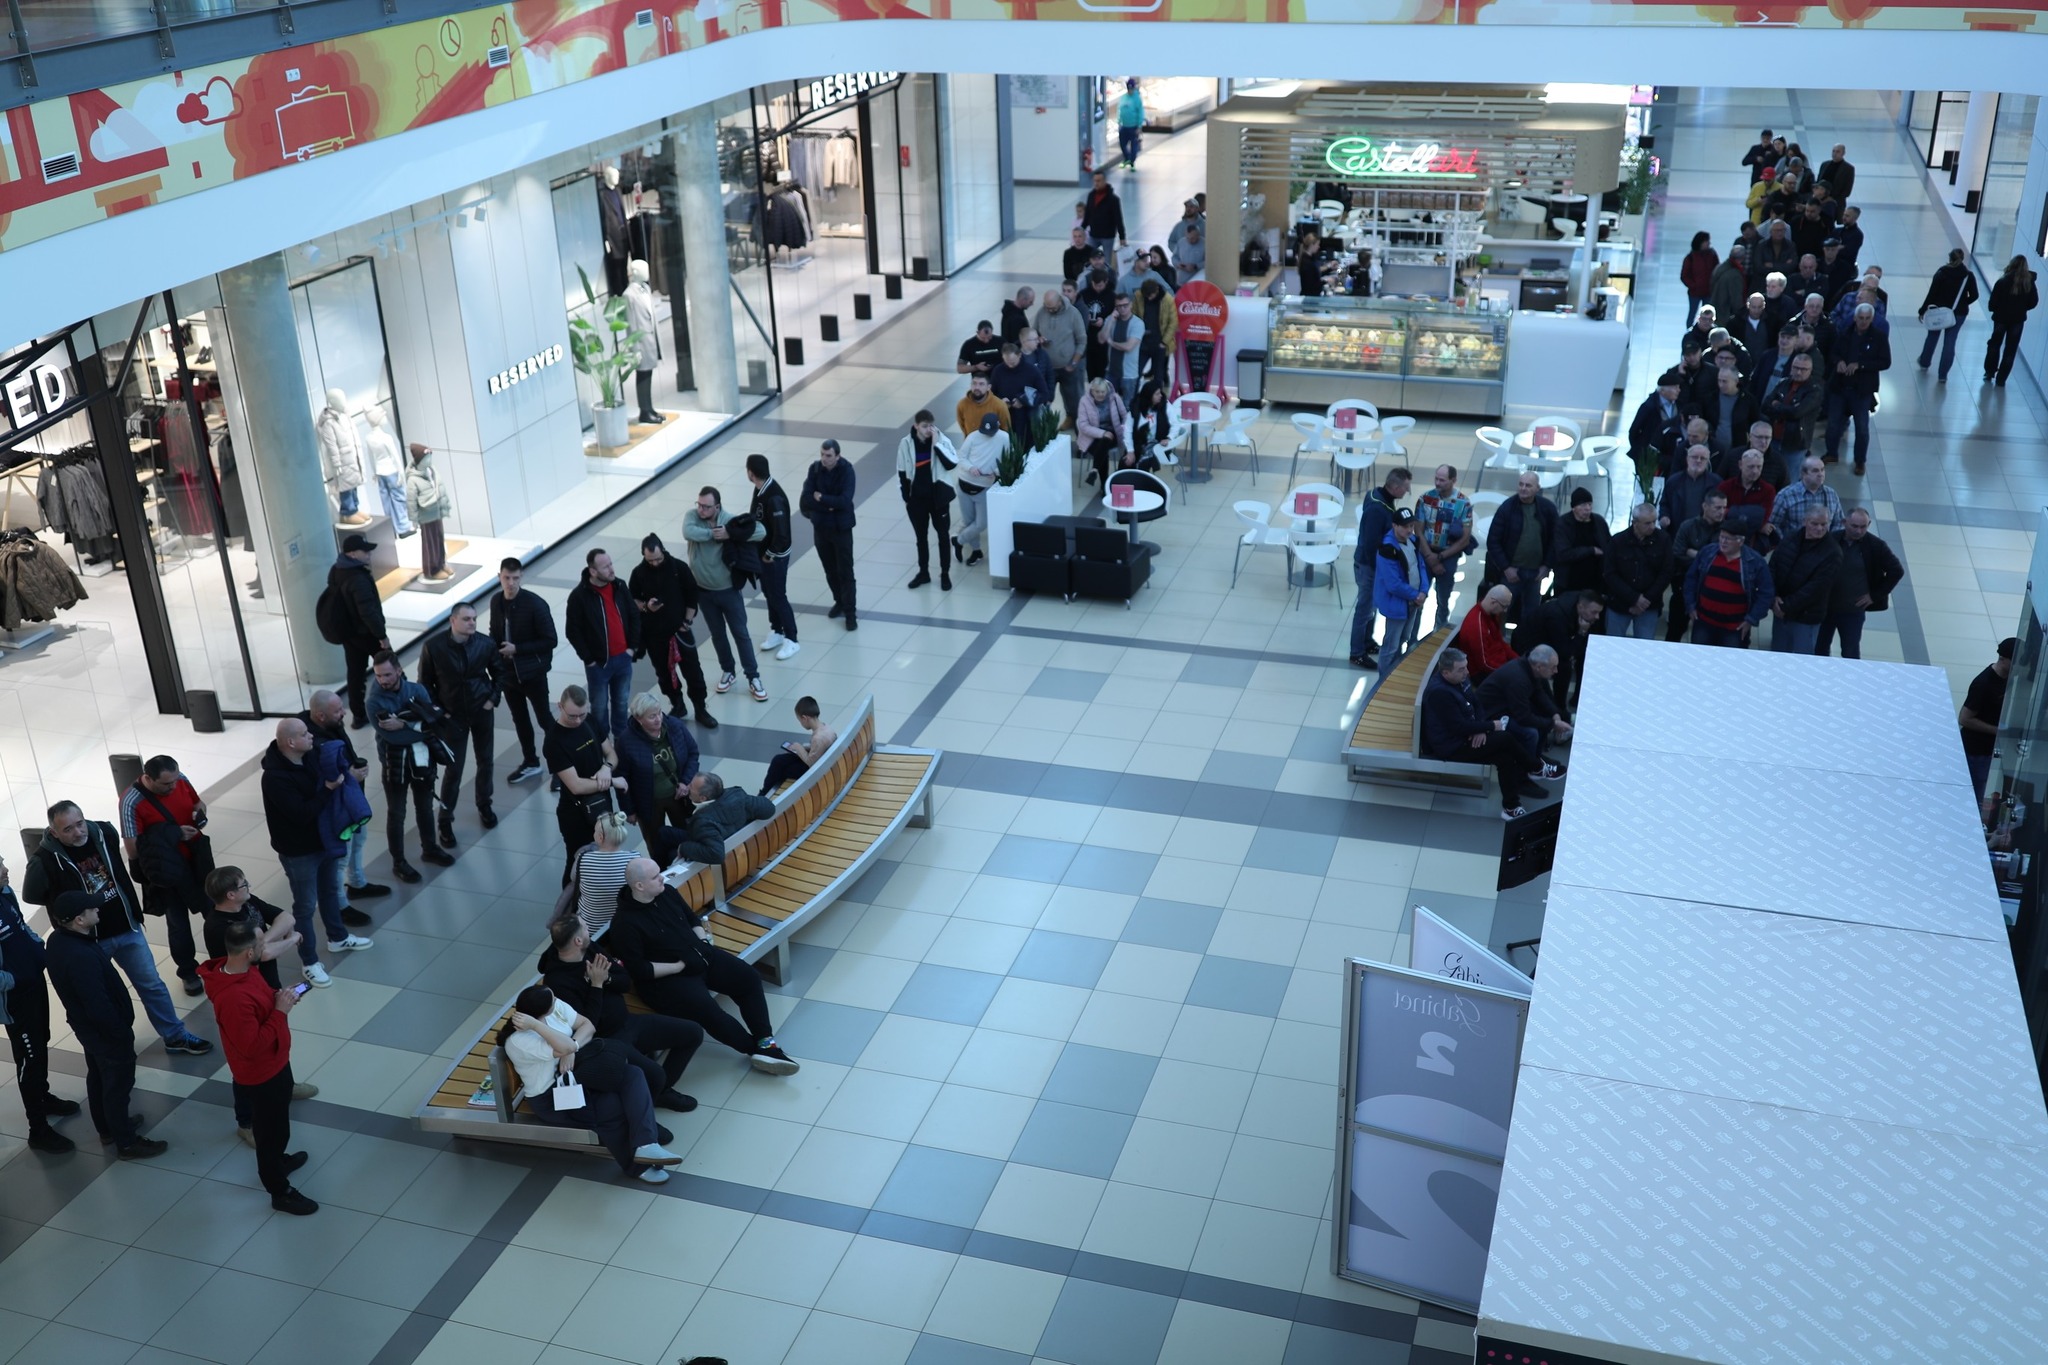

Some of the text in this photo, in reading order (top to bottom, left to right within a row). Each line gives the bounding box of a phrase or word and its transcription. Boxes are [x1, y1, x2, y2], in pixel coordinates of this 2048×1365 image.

[1325, 137, 1480, 178] Castellari
[489, 343, 563, 395] RESERVED
[1979, 1301, 2047, 1353] owarzyszenie
